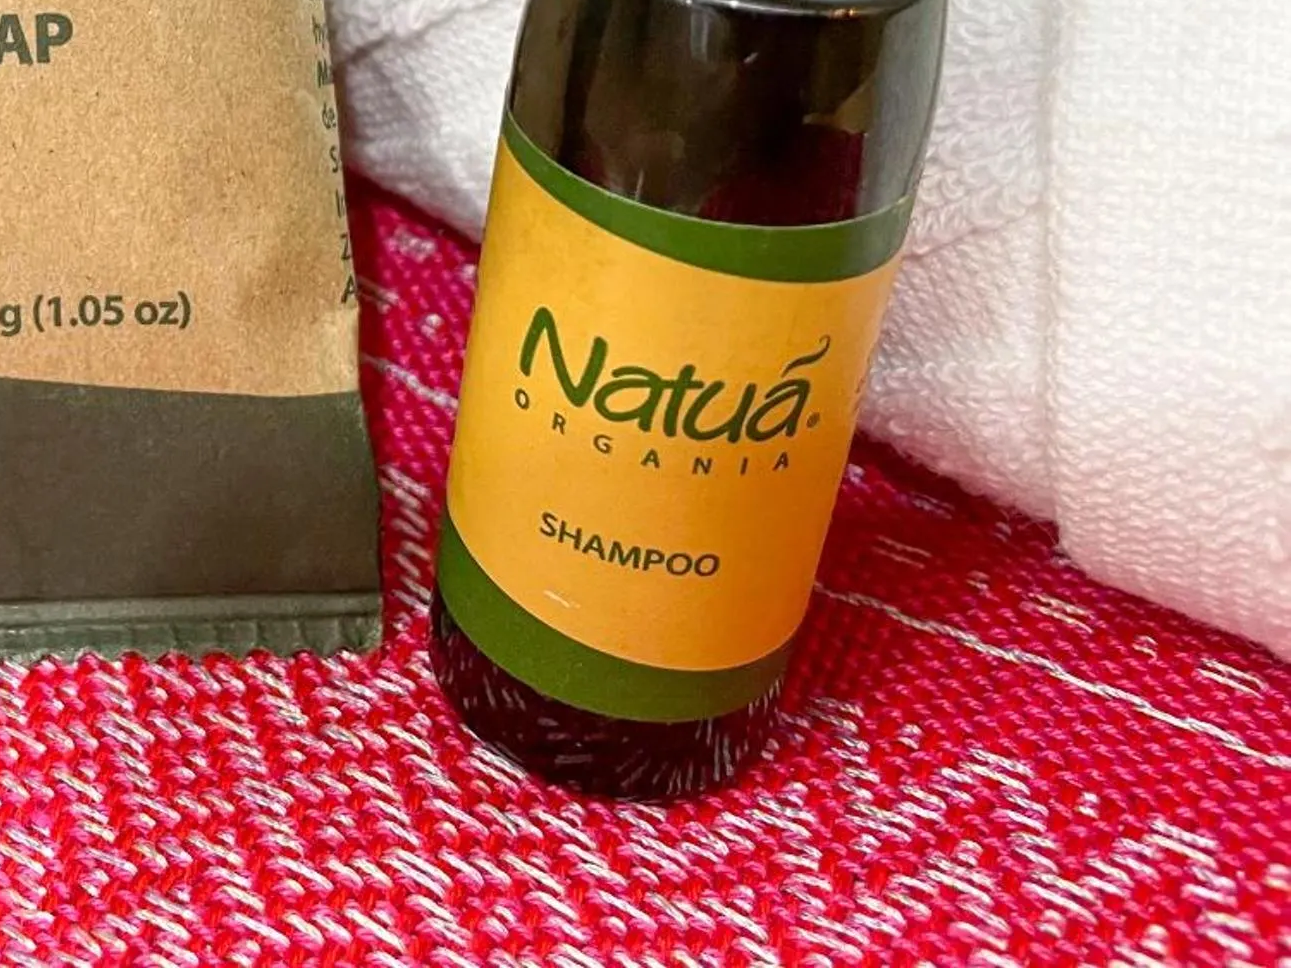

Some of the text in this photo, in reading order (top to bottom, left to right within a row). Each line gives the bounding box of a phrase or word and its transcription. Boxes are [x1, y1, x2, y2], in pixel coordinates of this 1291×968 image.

[32, 294, 124, 333] (1.05
[133, 291, 192, 330] oz)
[514, 388, 790, 476] ORGANIA
[539, 512, 720, 578] SHAMPOO
